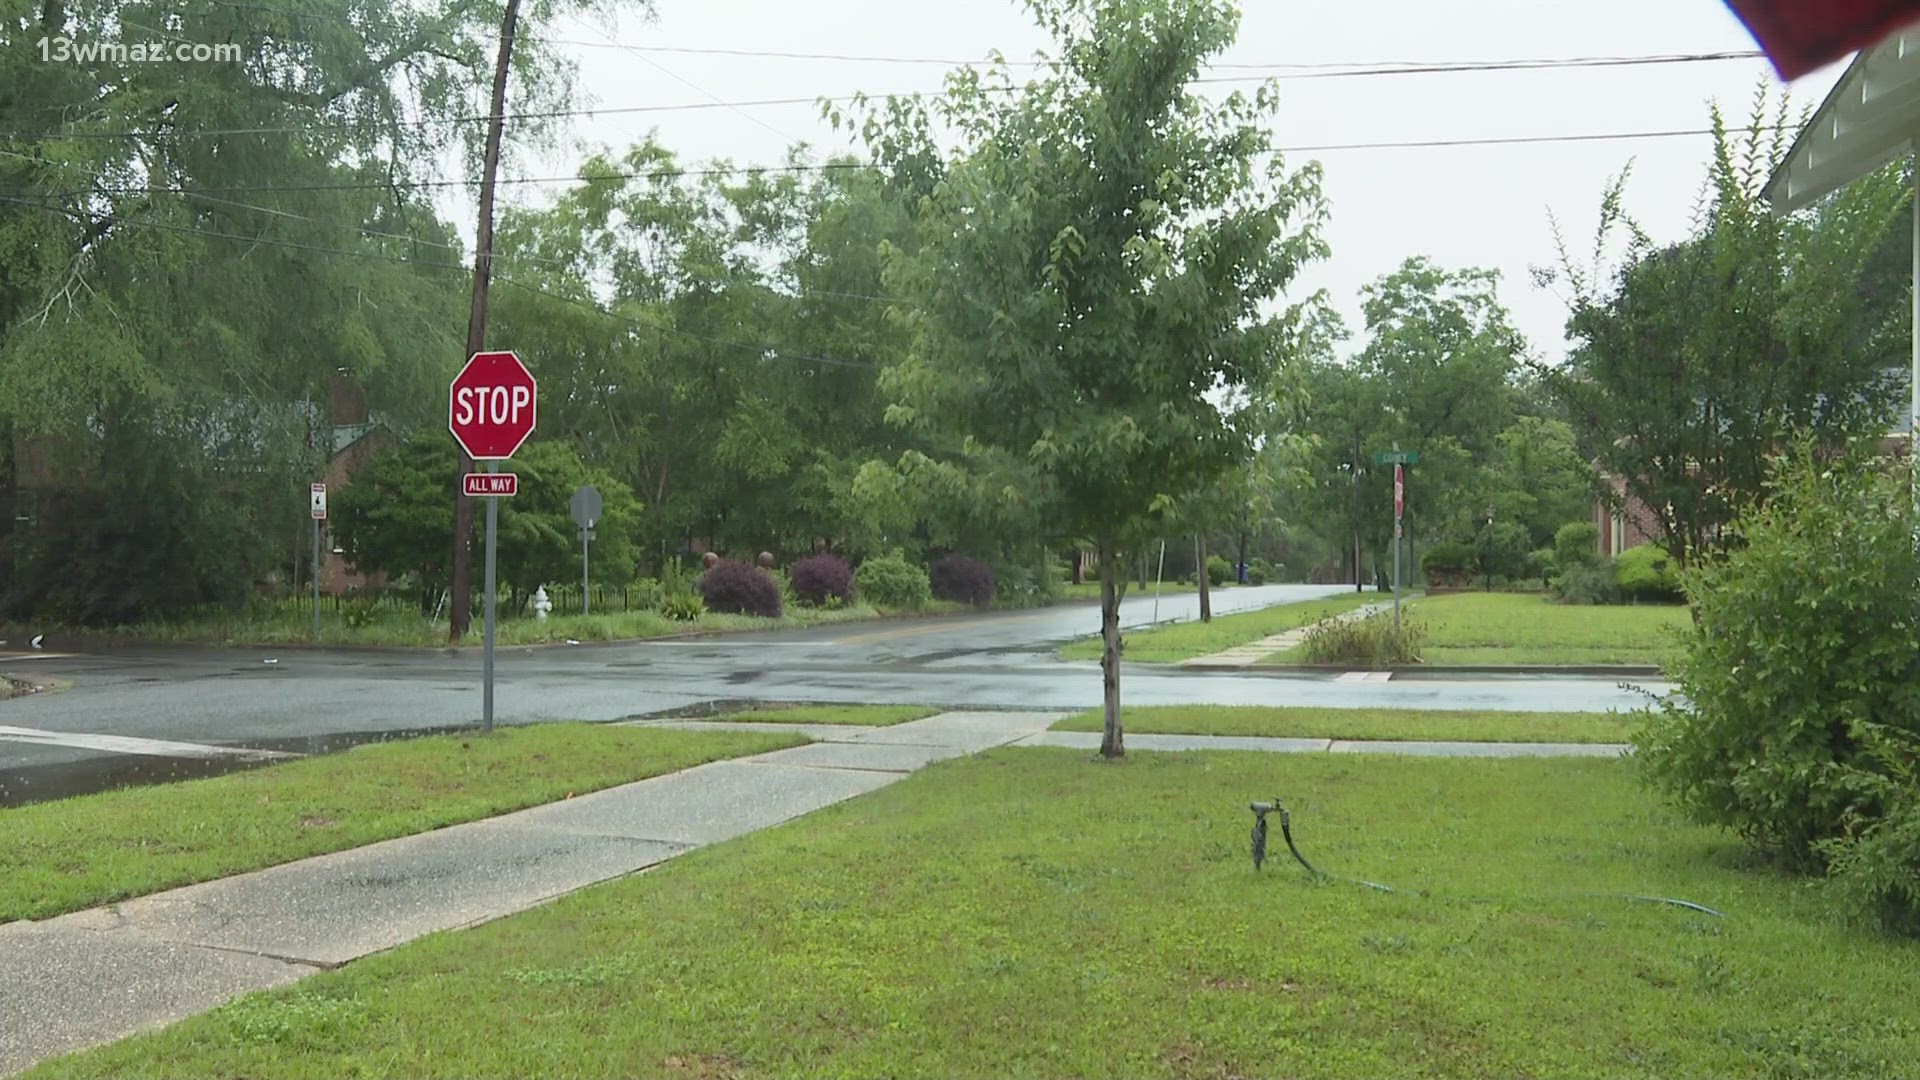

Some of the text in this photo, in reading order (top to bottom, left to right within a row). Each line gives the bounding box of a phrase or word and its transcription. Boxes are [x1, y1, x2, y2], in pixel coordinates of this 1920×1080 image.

[456, 385, 530, 425] STOP
[468, 478, 512, 491] ALL WAY
